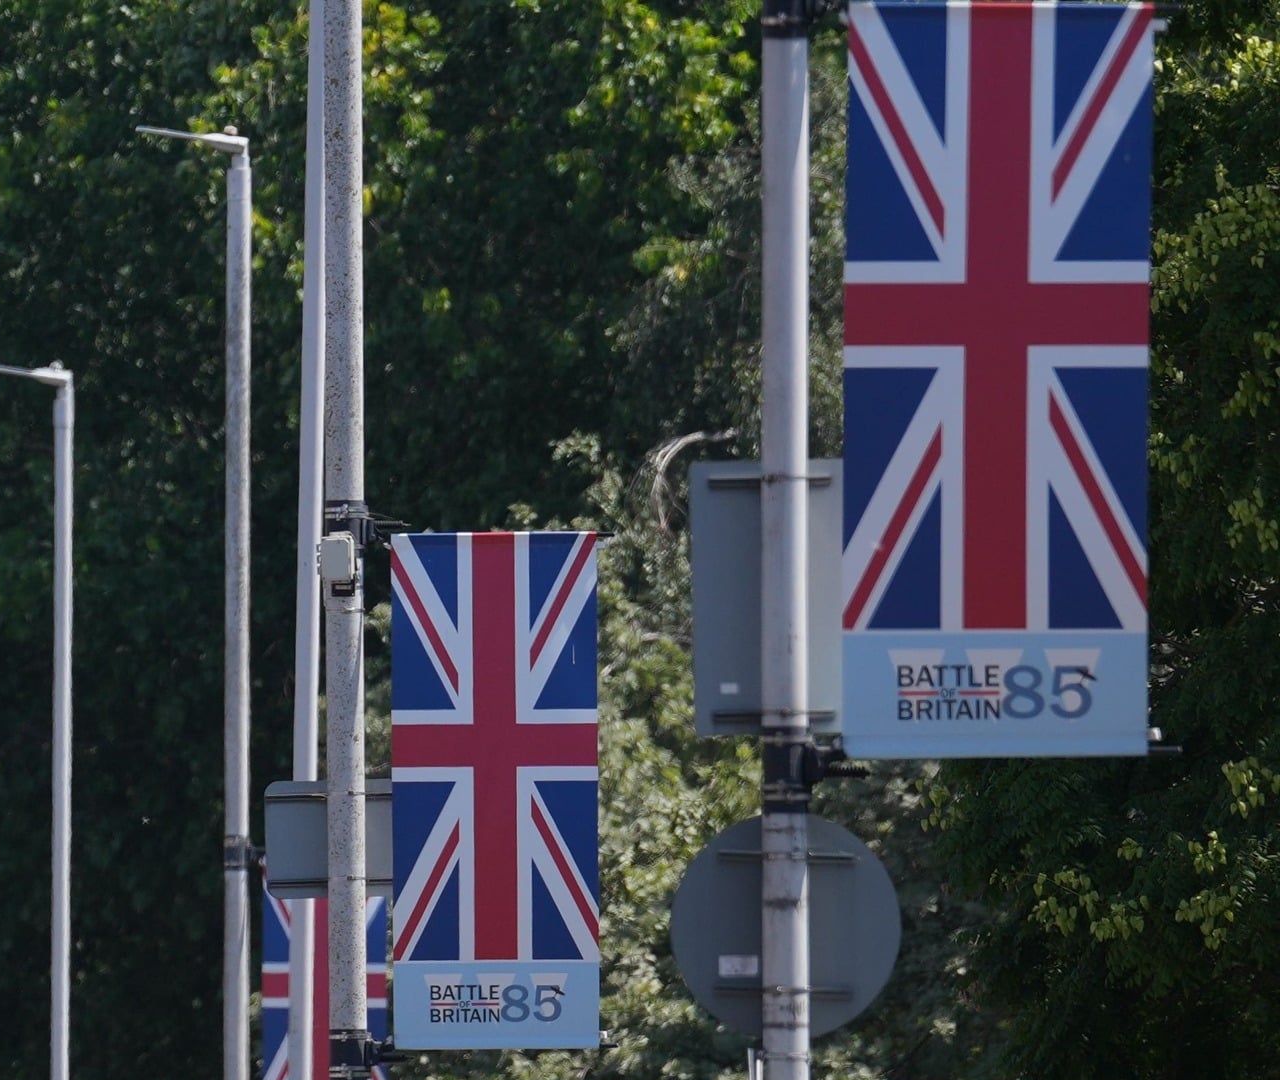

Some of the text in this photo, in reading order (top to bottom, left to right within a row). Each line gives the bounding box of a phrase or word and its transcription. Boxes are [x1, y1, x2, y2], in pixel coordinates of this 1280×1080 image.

[897, 665, 1000, 687] BATTLE
[941, 688, 956, 698] OF
[1002, 665, 1093, 719] 85
[897, 700, 1000, 720] BRITAIN
[430, 985, 500, 1000] BATTLE
[501, 985, 562, 1023] 85
[430, 1008, 500, 1023] BRITAIN
